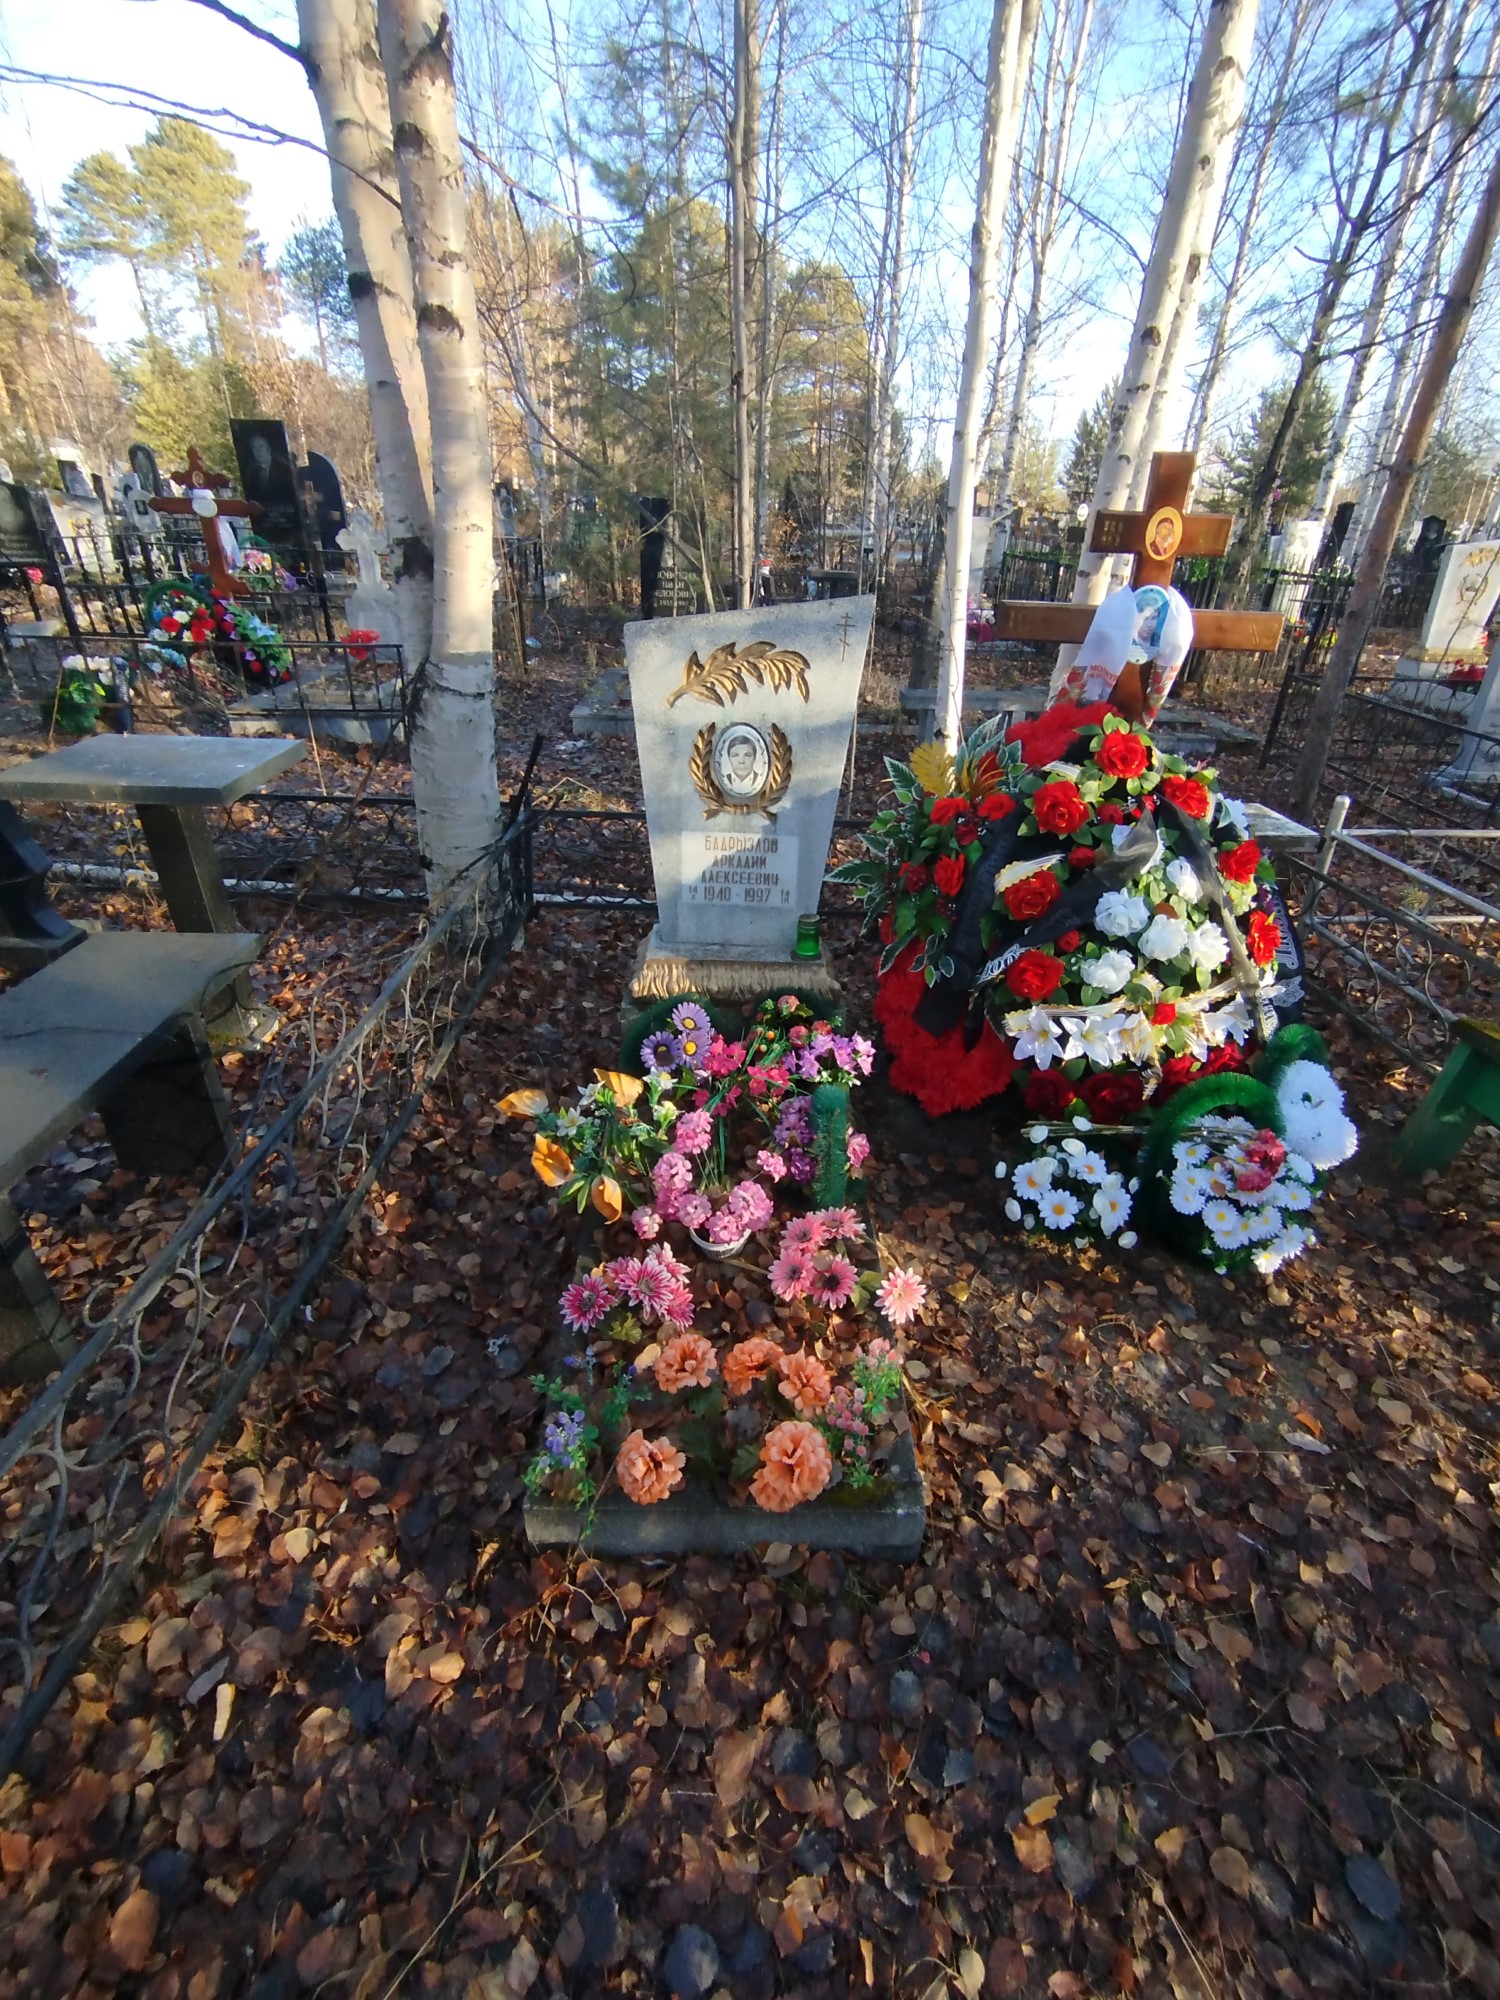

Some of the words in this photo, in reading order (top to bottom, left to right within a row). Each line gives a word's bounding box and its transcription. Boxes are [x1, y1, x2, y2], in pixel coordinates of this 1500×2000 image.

[701, 870, 780, 886] АЛЕКСЕЕВИЧ
[704, 886, 732, 901] 1940
[744, 888, 772, 903] 1997
